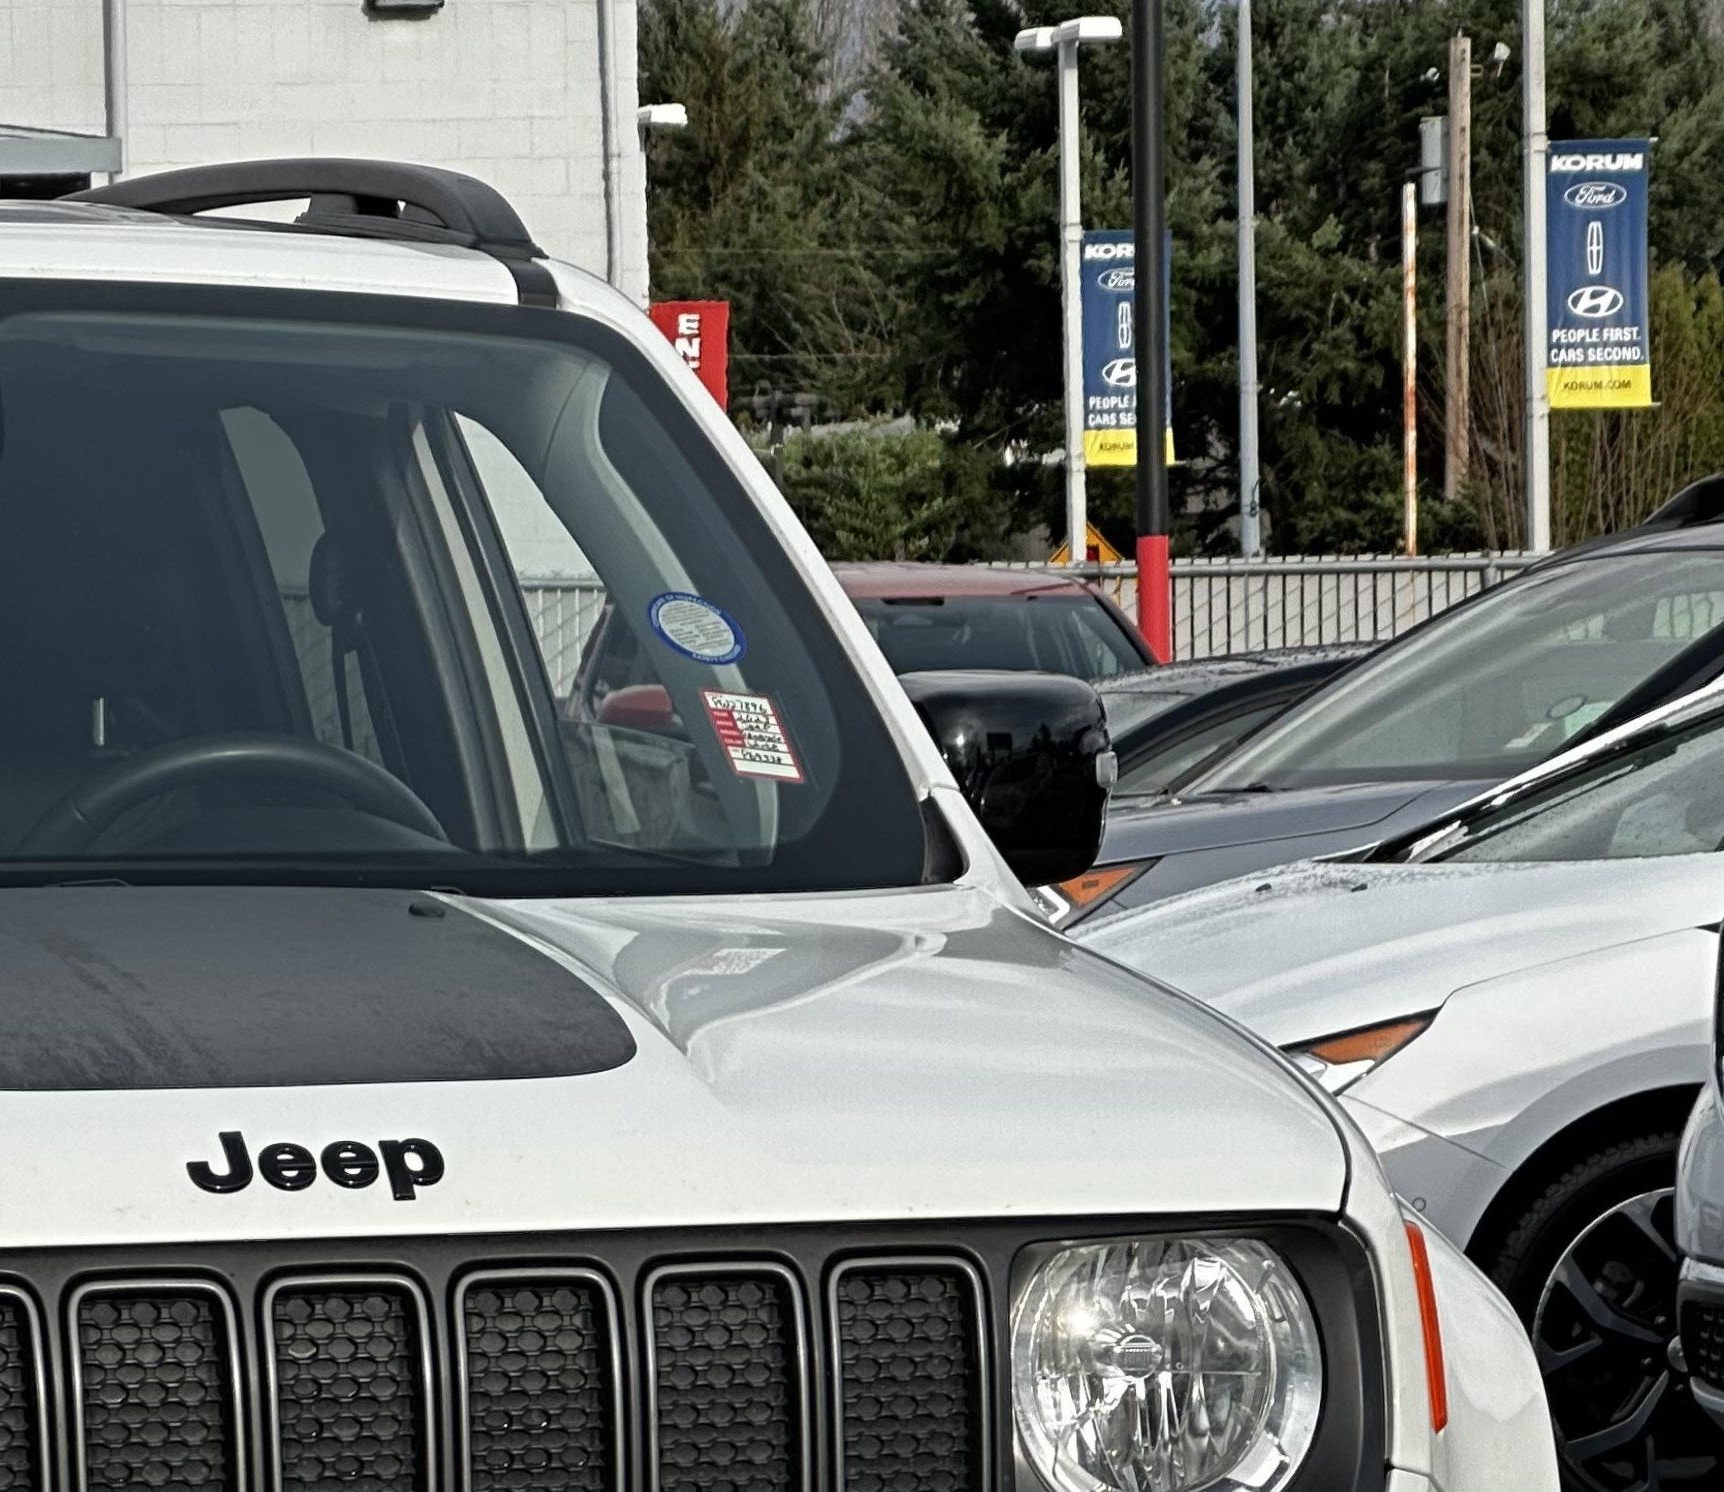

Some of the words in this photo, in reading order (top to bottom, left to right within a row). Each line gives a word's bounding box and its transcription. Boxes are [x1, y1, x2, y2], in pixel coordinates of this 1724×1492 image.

[1551, 153, 1644, 171] KORUM
[1575, 185, 1617, 206] Ford
[1084, 243, 1135, 259] KOR
[1107, 271, 1135, 288] For
[1552, 328, 1599, 342] PEOPLE
[1603, 326, 1641, 341] FIRST.
[1550, 348, 1584, 363] CARS
[1588, 346, 1644, 361] SECOND.
[1563, 380, 1632, 390] KORUM.COM
[1089, 395, 1129, 409] PEOPLE
[1088, 413, 1117, 427] CARS
[186, 1131, 445, 1201] Jeep
